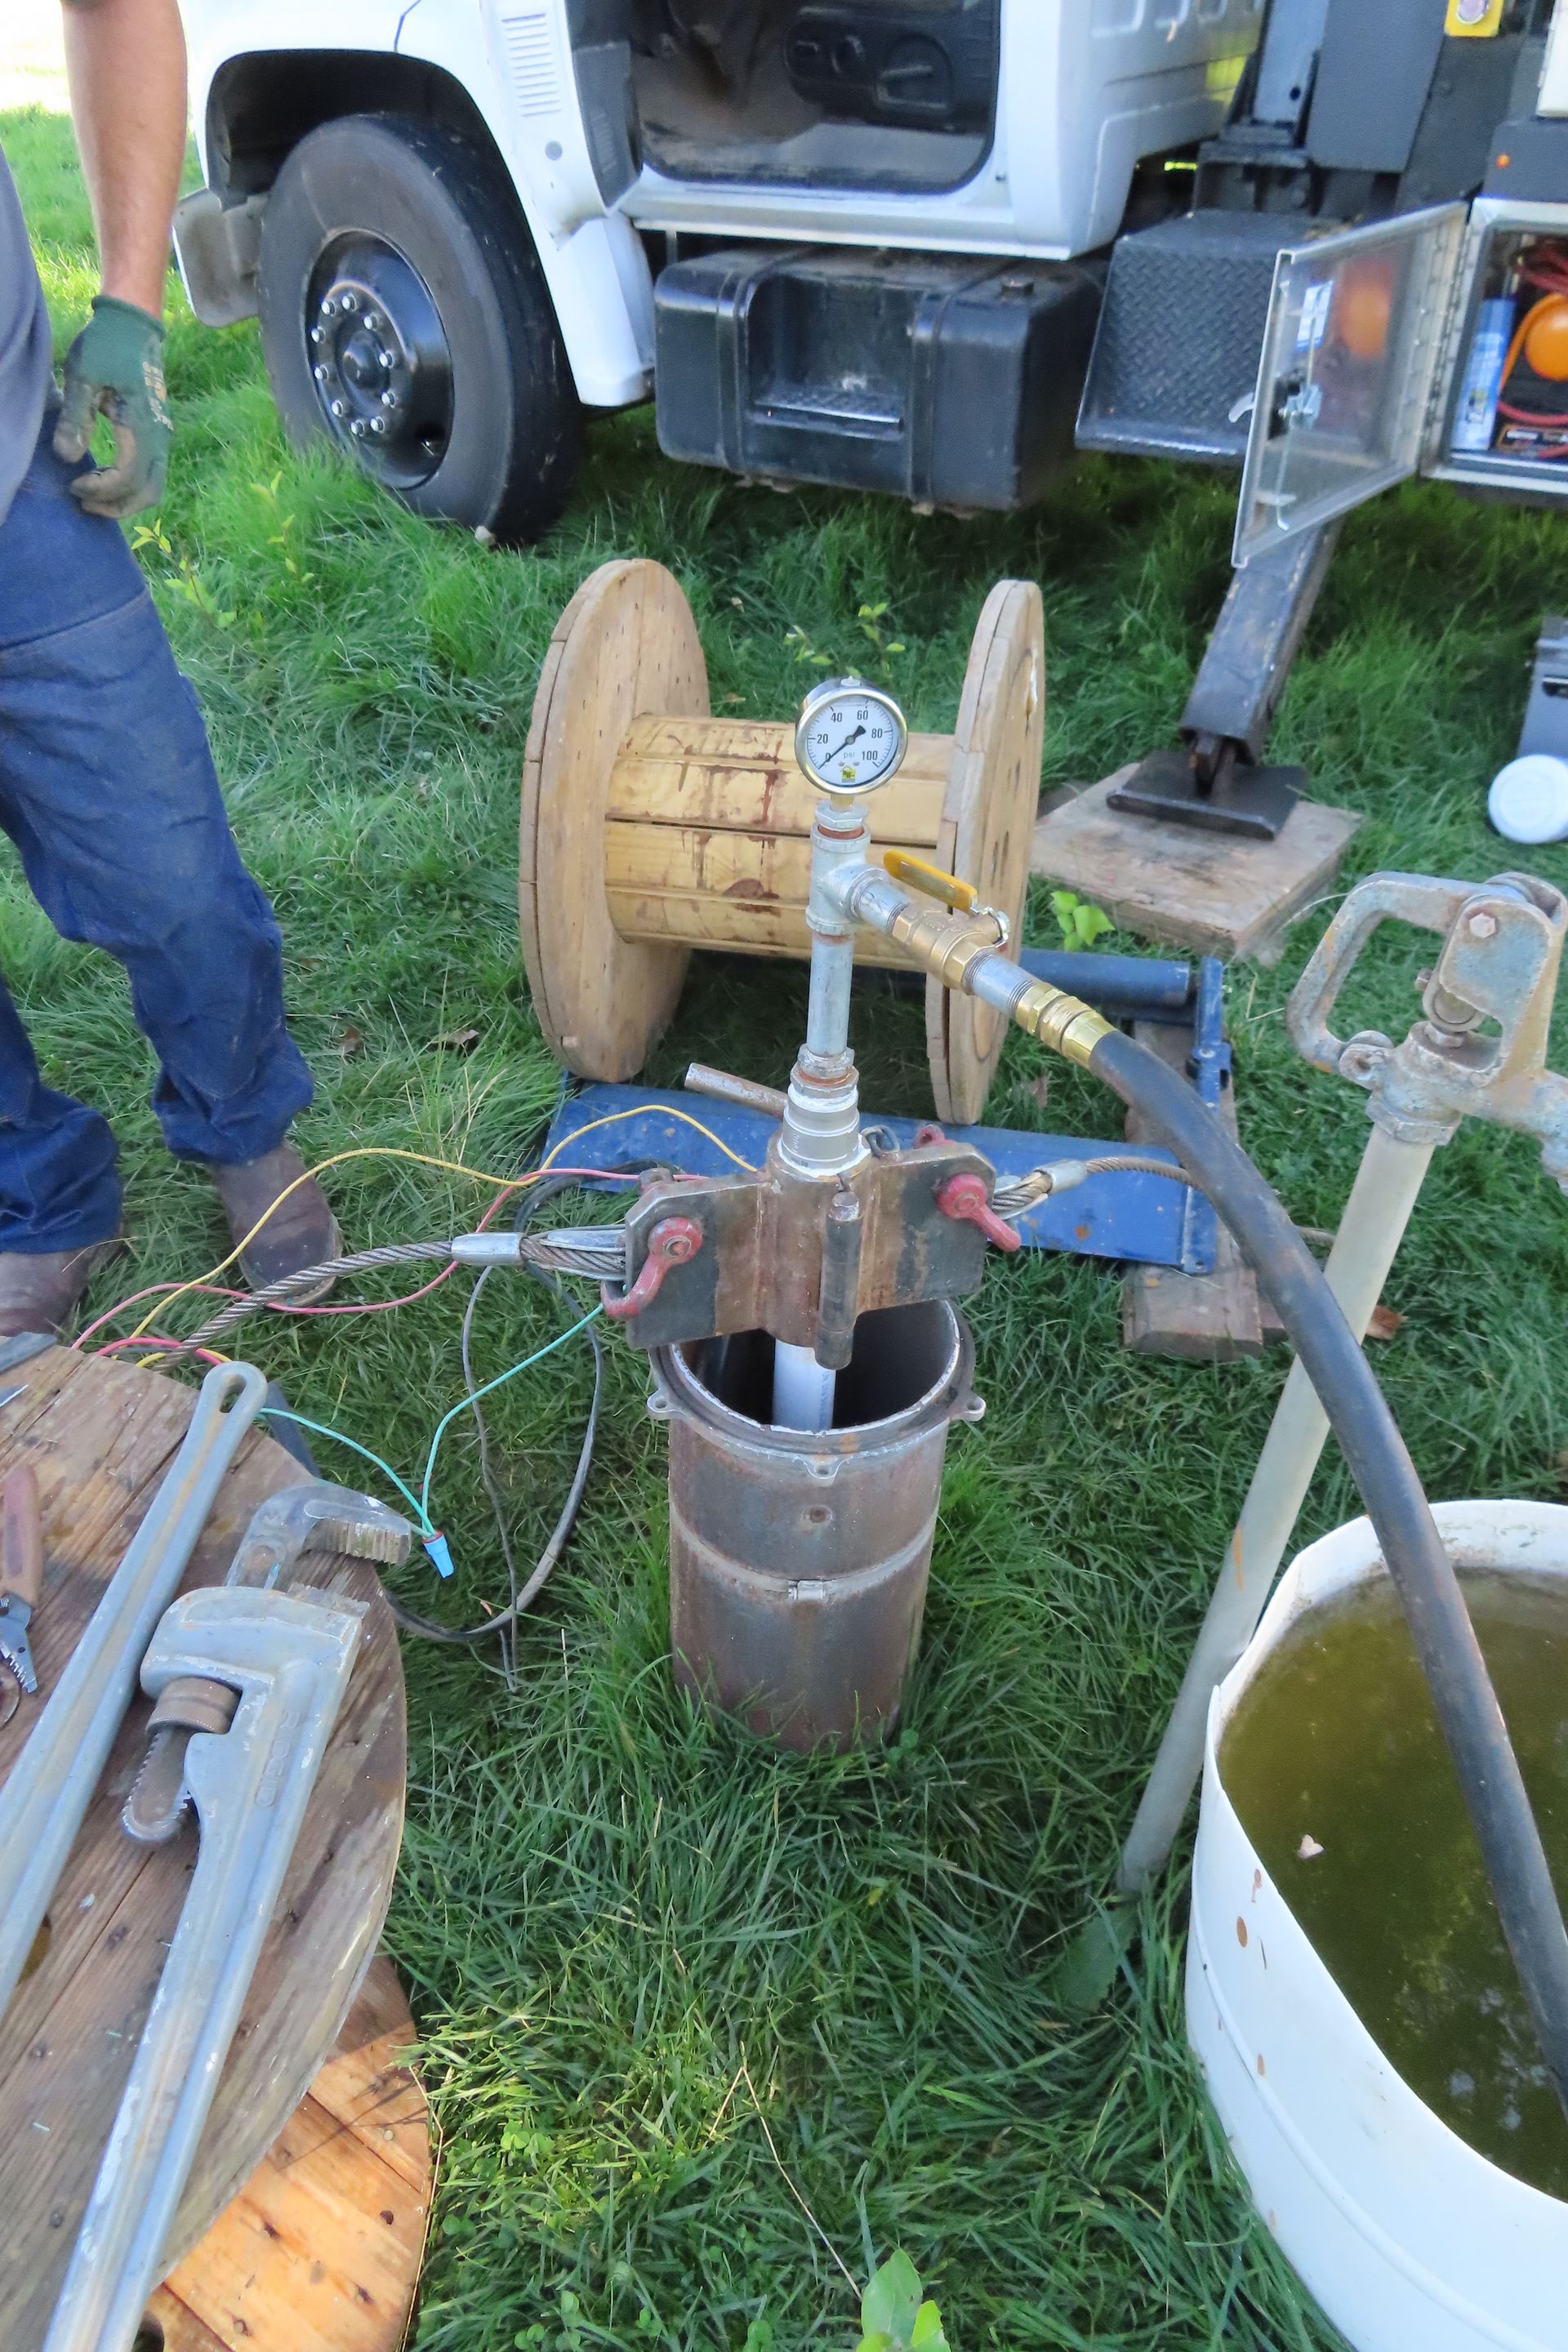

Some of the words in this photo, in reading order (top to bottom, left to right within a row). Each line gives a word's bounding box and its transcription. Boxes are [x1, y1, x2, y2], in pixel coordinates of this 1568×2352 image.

[831, 712, 843, 723] 40
[857, 710, 868, 720] 60
[871, 728, 883, 738] 80
[817, 733, 828, 744] 20
[825, 752, 831, 762] 0
[844, 751, 855, 760] psi
[862, 751, 878, 760] 100
